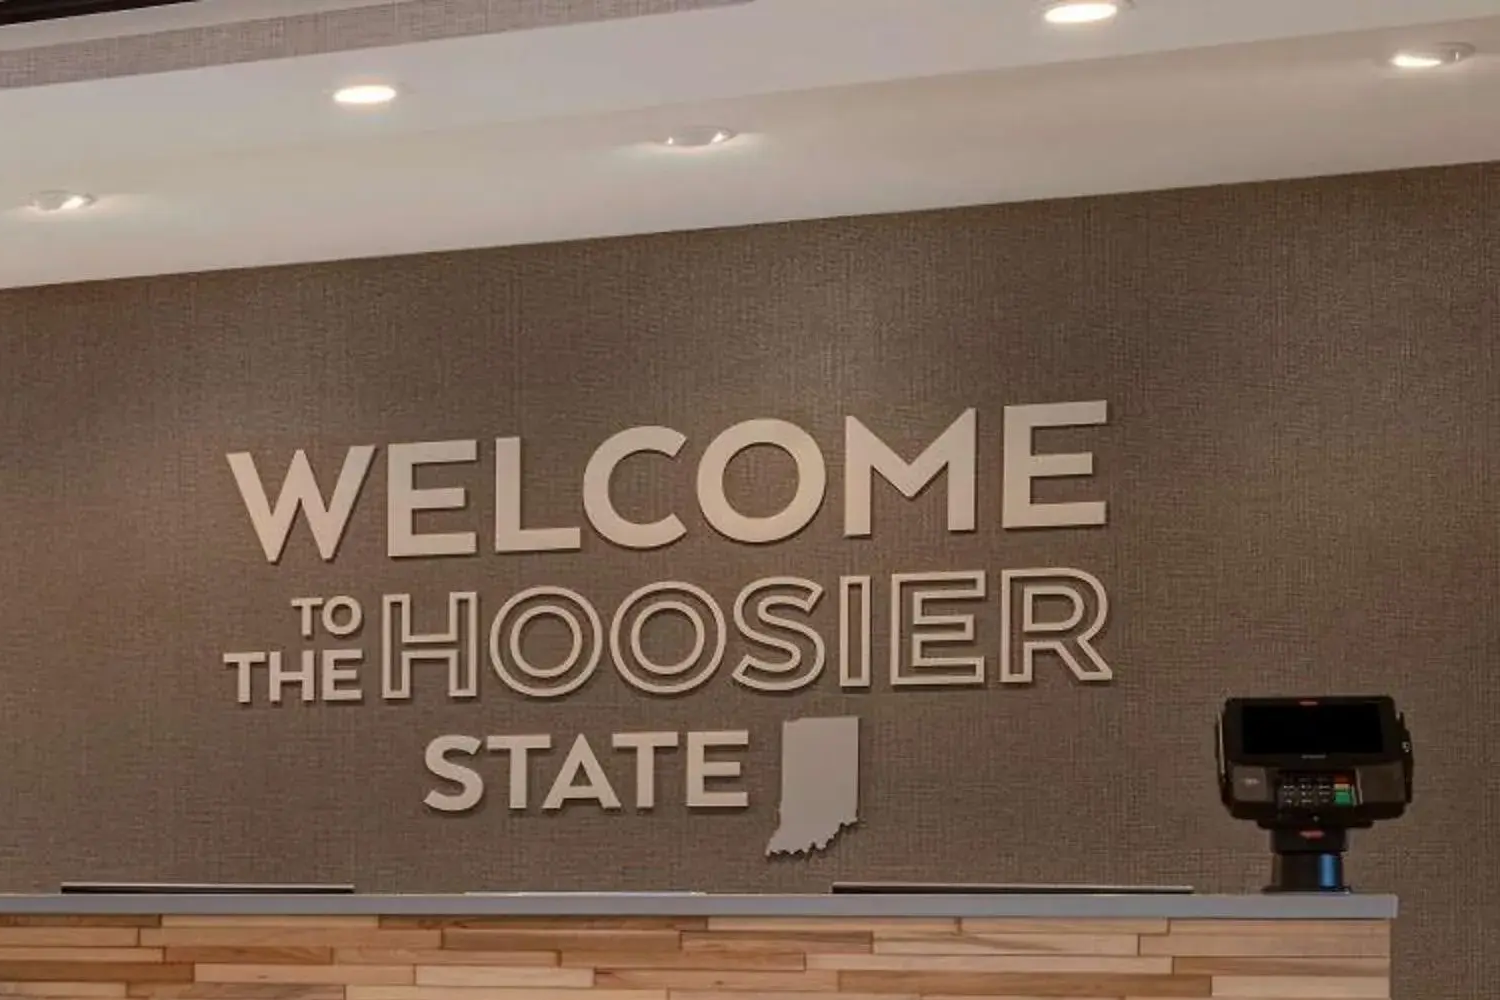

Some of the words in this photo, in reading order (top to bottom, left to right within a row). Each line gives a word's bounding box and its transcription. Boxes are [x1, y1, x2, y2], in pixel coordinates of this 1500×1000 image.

[227, 399, 1108, 563] WELCOME
[223, 648, 362, 704] THE
[381, 567, 1113, 701] HOOSIER
[291, 595, 363, 637] TO
[424, 729, 749, 813] STATE
